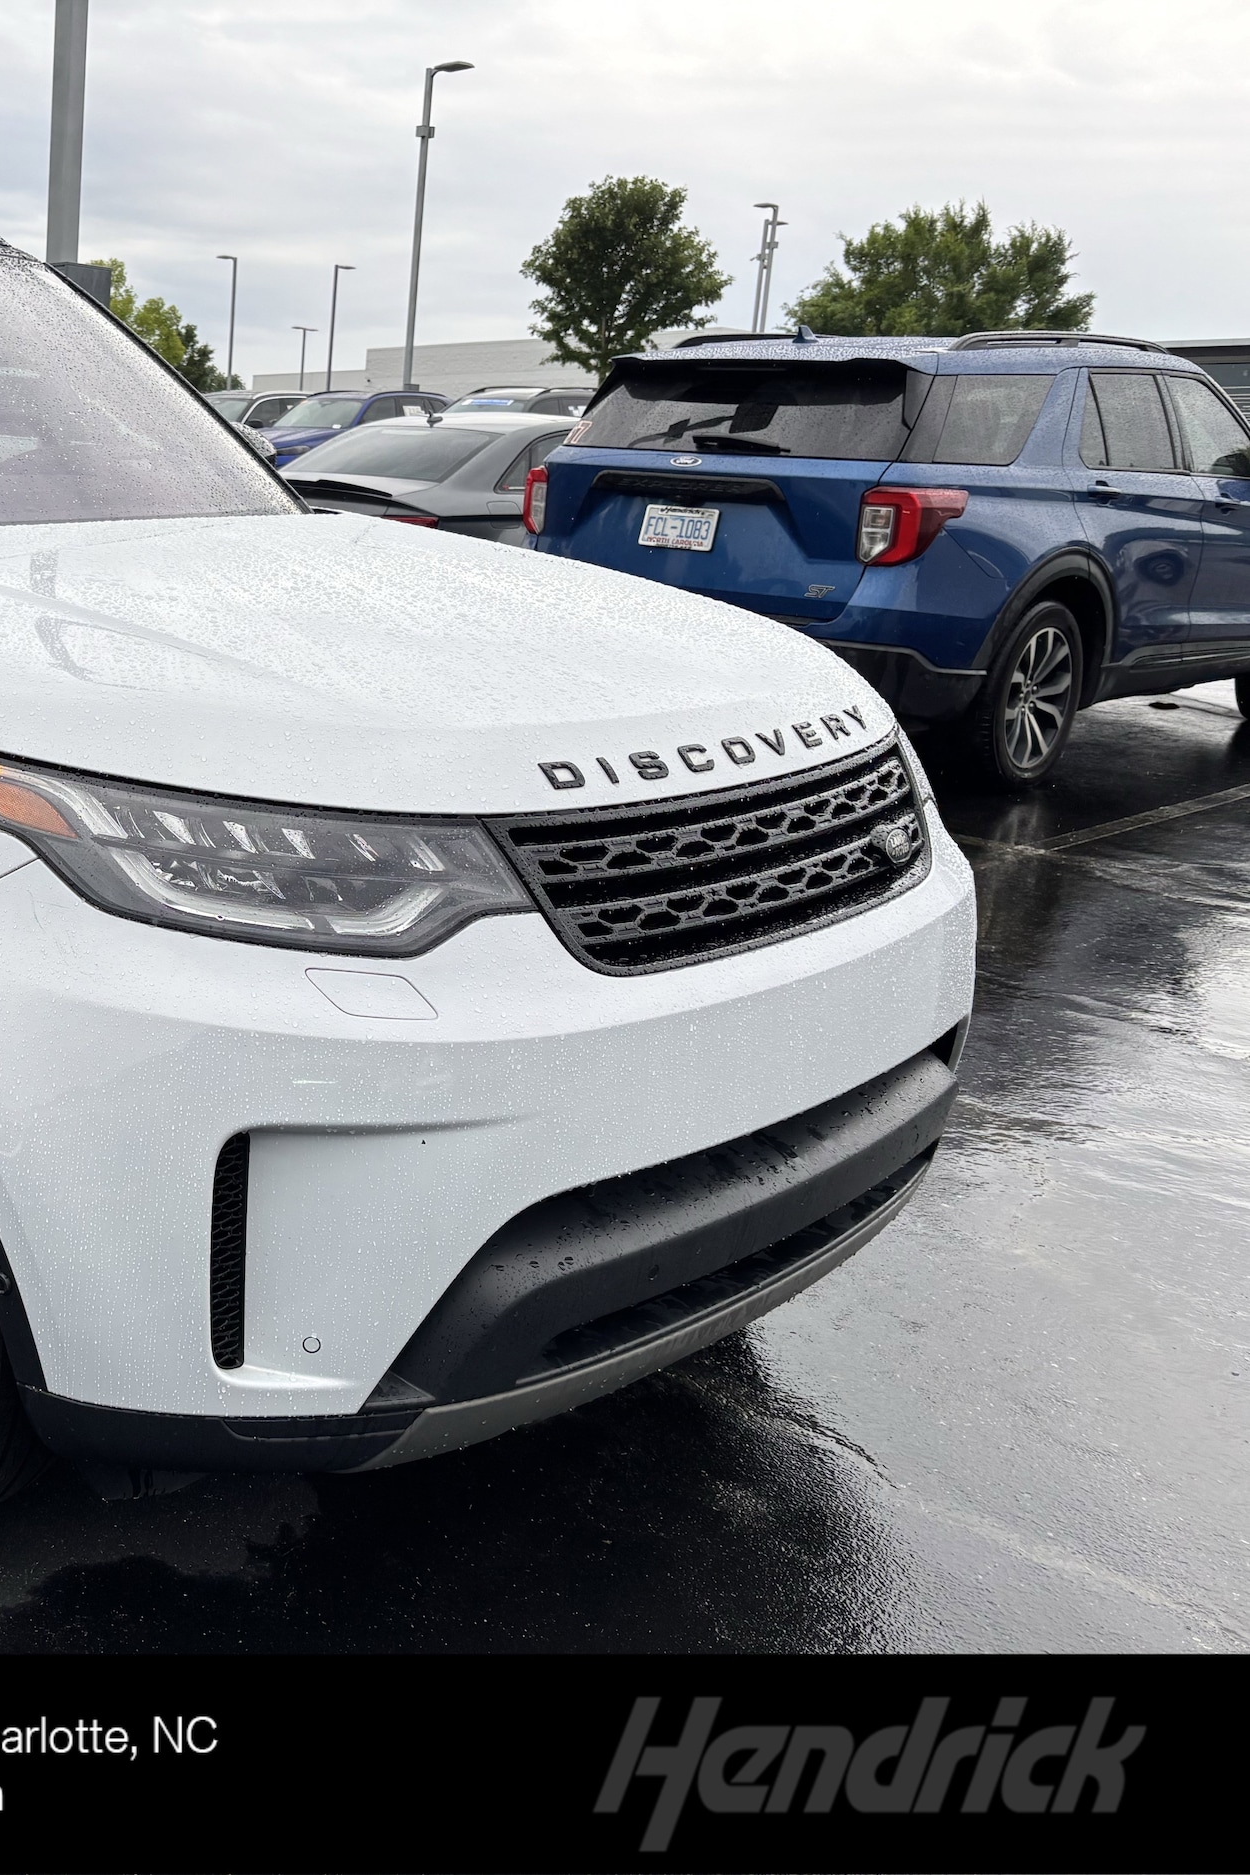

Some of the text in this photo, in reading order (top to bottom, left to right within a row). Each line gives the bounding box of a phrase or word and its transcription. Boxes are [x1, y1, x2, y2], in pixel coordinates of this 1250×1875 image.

[644, 516, 711, 540] FCL-1083
[803, 584, 835, 598] ST
[537, 705, 869, 790] DISCOVERY
